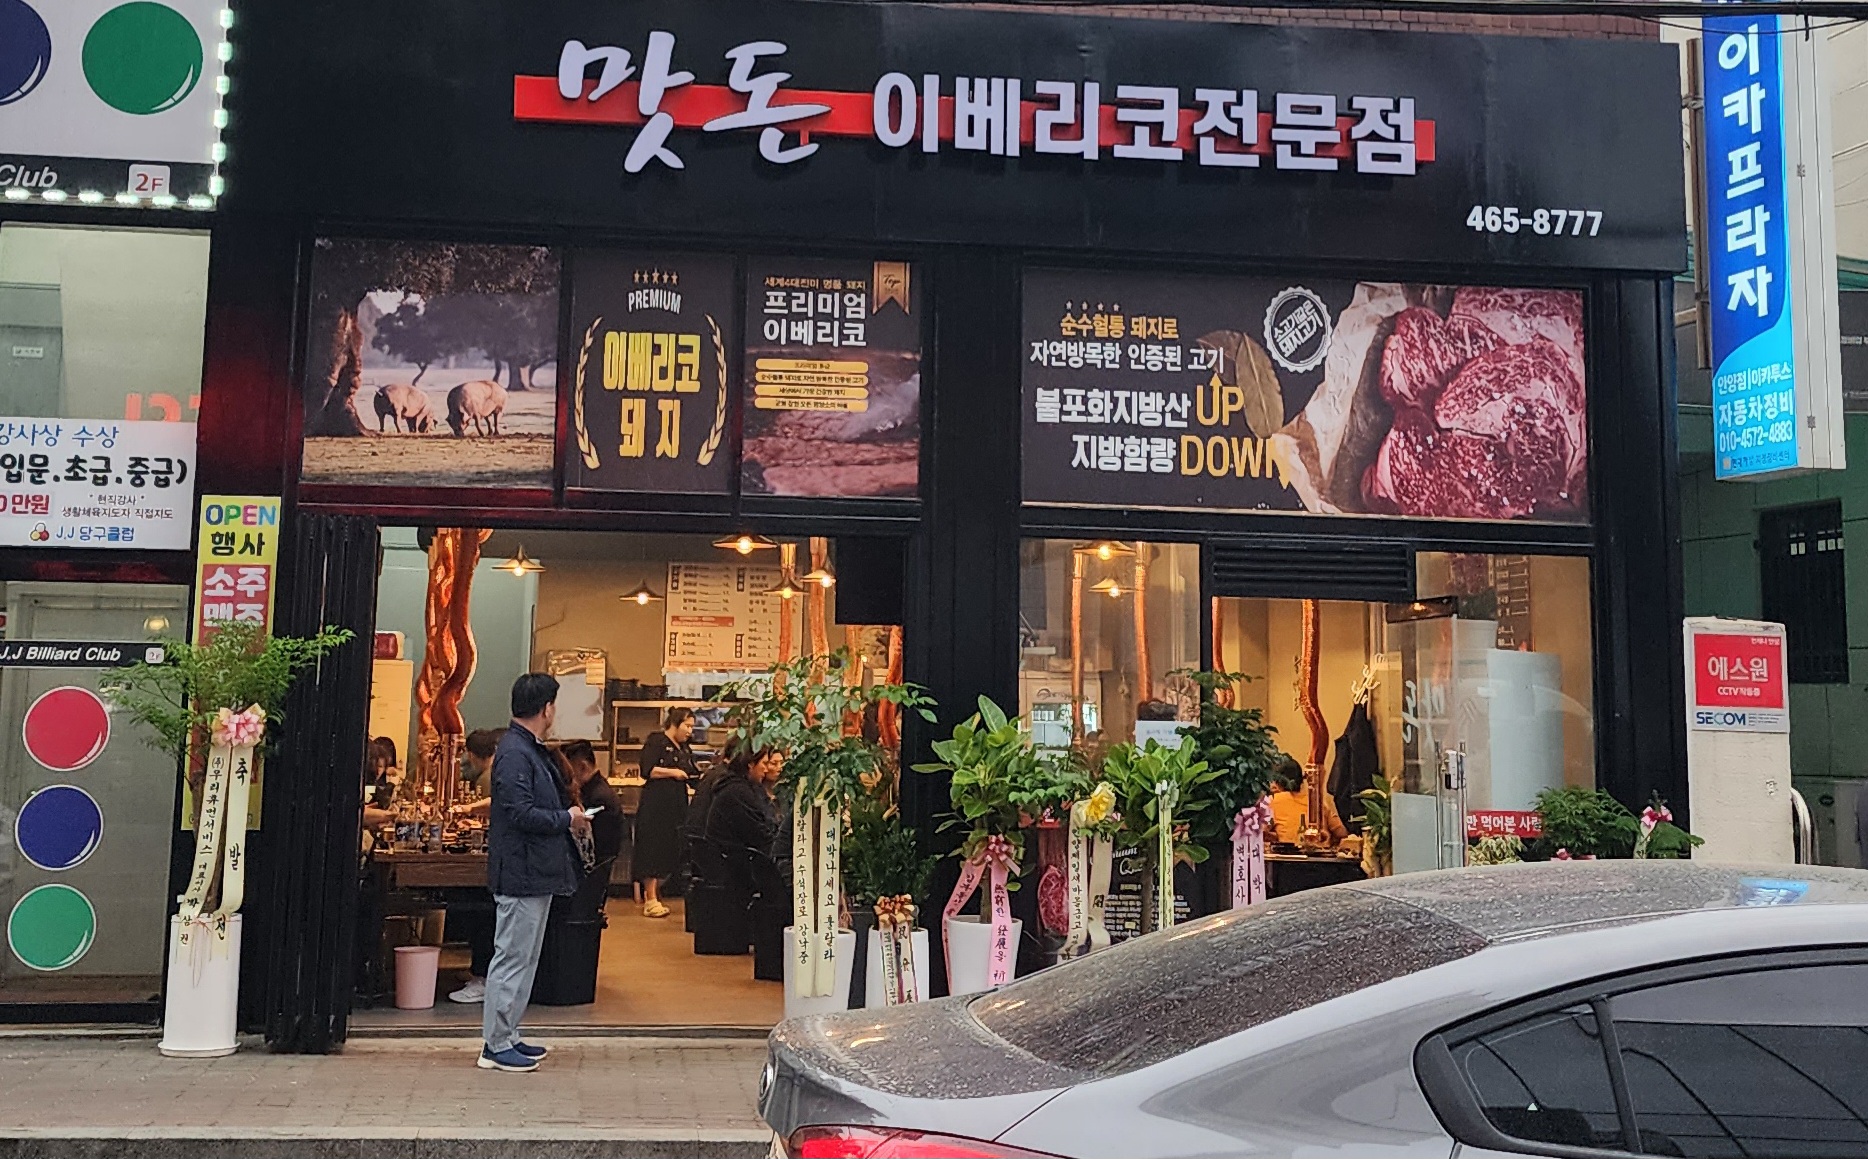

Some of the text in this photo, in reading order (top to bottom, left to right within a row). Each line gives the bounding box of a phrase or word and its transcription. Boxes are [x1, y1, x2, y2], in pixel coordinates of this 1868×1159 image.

[873, 72, 1415, 175] 이베리코전문점
[0, 164, 164, 192] Club 2F
[1718, 24, 1772, 317] 이카프라자
[1466, 206, 1603, 238] 465-8777
[628, 289, 682, 314] PREMIUM
[763, 291, 866, 319] 프리미엄
[763, 318, 866, 347] 이베리코
[1130, 316, 1179, 340] 돼지로
[1279, 312, 1324, 358] 돼지고기
[603, 331, 701, 392] 이베리코
[1030, 340, 1224, 374] 자연방목한 인증된 고기
[1717, 372, 1747, 395] 안양점
[1035, 384, 1245, 428] 불포화지방산 UP
[1719, 388, 1794, 428] 자동차정비
[72, 424, 119, 449] 수상
[619, 398, 681, 458] 돼지
[1719, 420, 1793, 452] 010-4572-4883
[1072, 435, 1176, 473] 지방함량
[62, 506, 173, 519] 생활체육지도자 직접지도
[98, 494, 137, 505] 현직강사
[205, 504, 276, 526] OPEN
[56, 526, 135, 541] J.J 당구클럽
[211, 532, 265, 557] 행사
[203, 567, 266, 598] 소주
[0, 646, 22, 661] J.J
[26, 646, 82, 661] Billiard
[85, 647, 121, 662] Club
[1707, 656, 1769, 682] 에스원
[1696, 711, 1746, 726] SECOM
[235, 758, 248, 786] 축
[1481, 814, 1516, 833] 먹어본
[825, 827, 837, 907] 대박나세요
